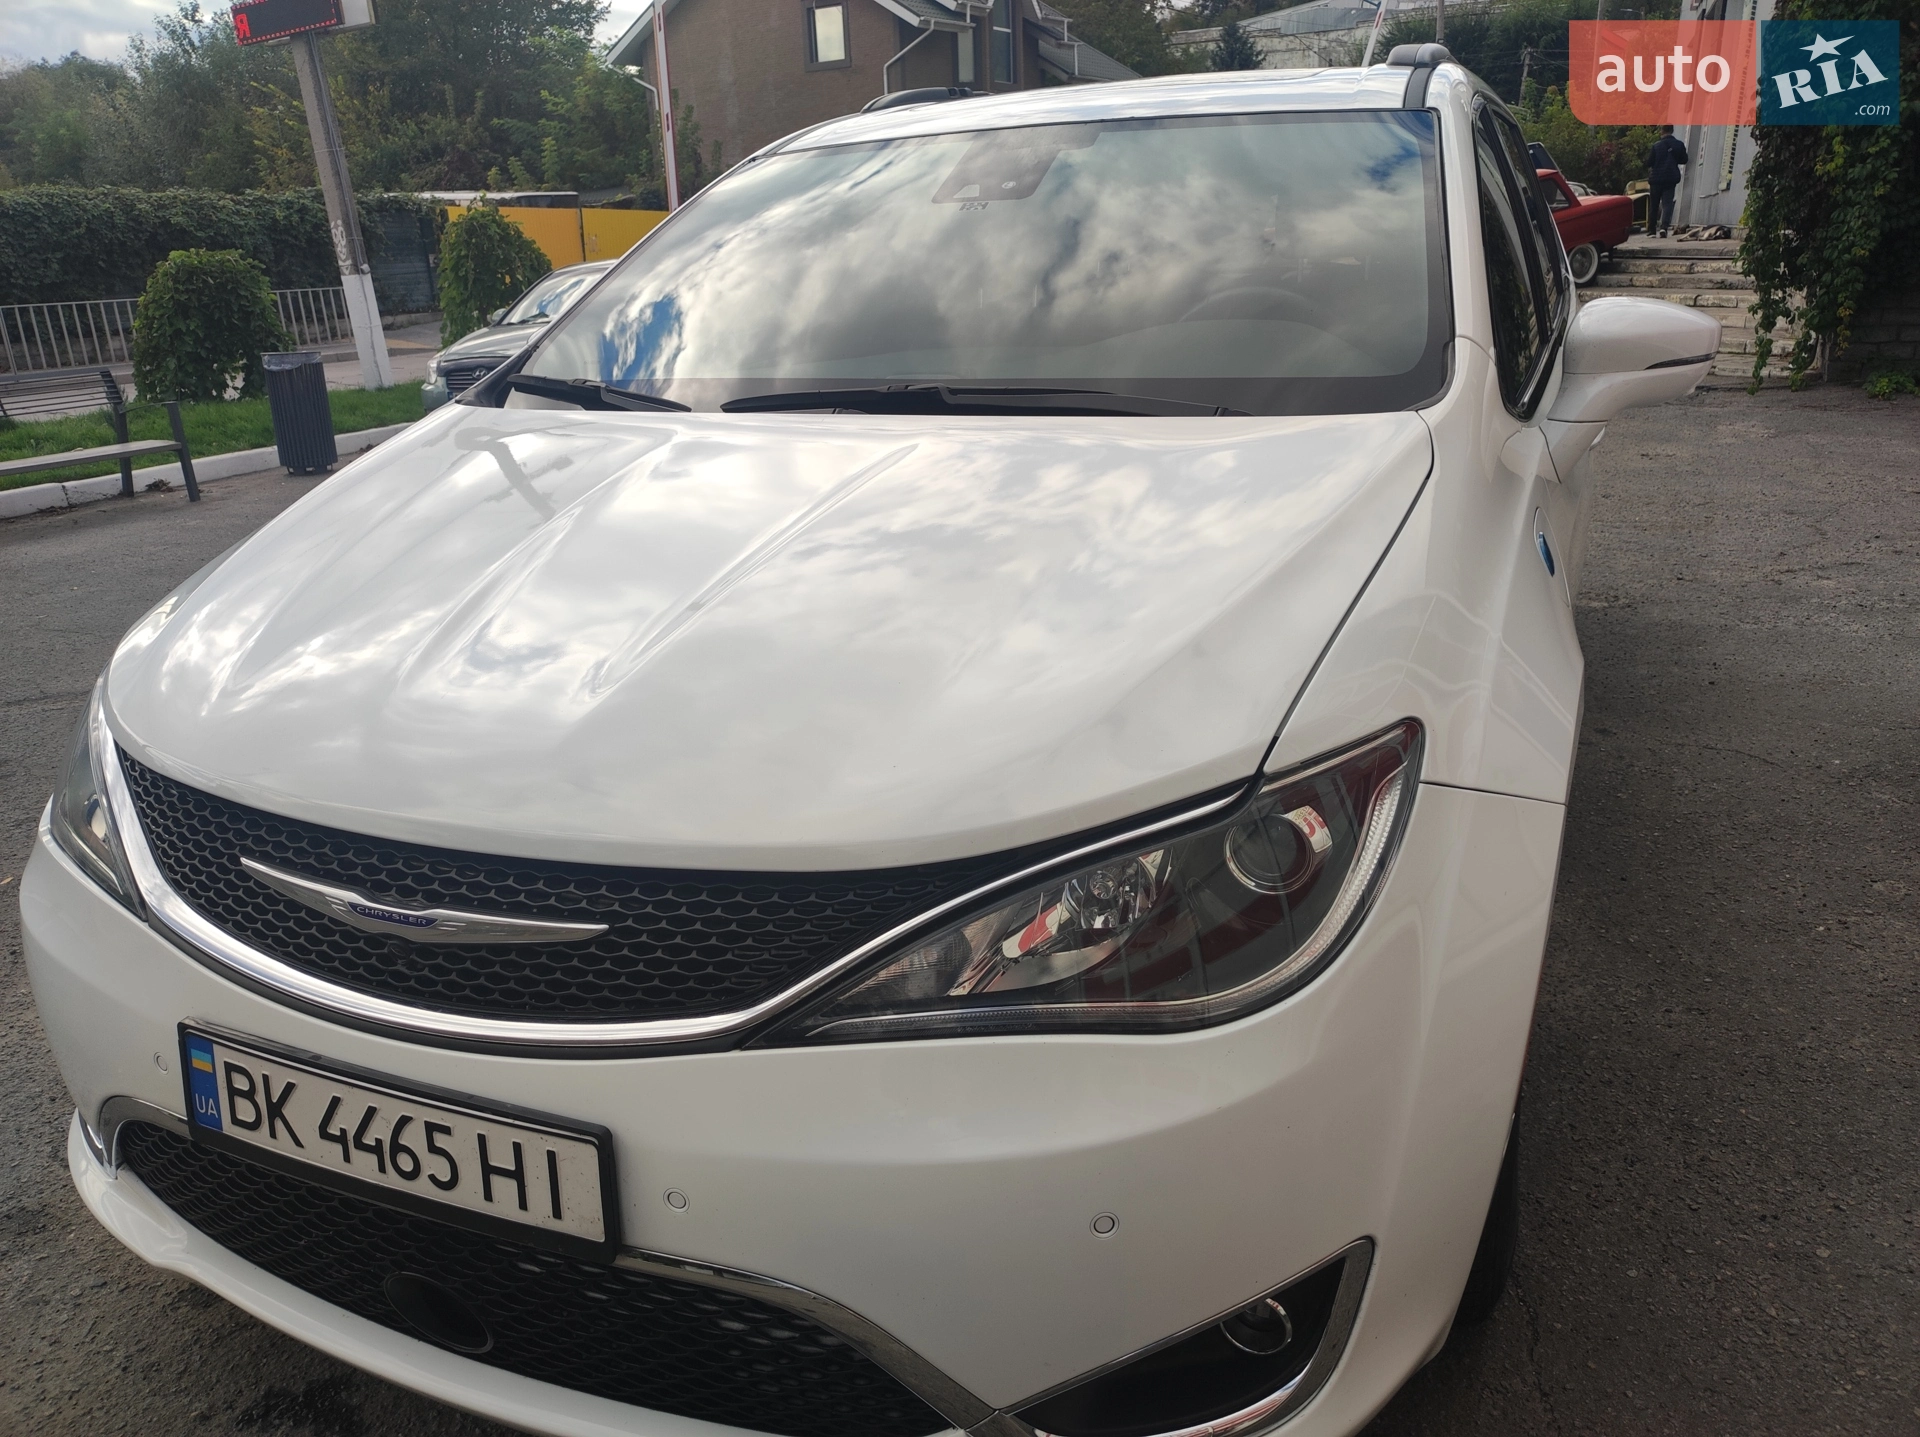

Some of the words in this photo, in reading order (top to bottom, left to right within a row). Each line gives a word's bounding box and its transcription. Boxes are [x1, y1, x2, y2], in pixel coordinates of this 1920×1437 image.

[356, 906, 427, 925] CHRYSLER
[195, 1093, 218, 1118] UA
[223, 1060, 304, 1149] BK
[318, 1094, 460, 1191] 4465
[476, 1132, 563, 1220] HI
